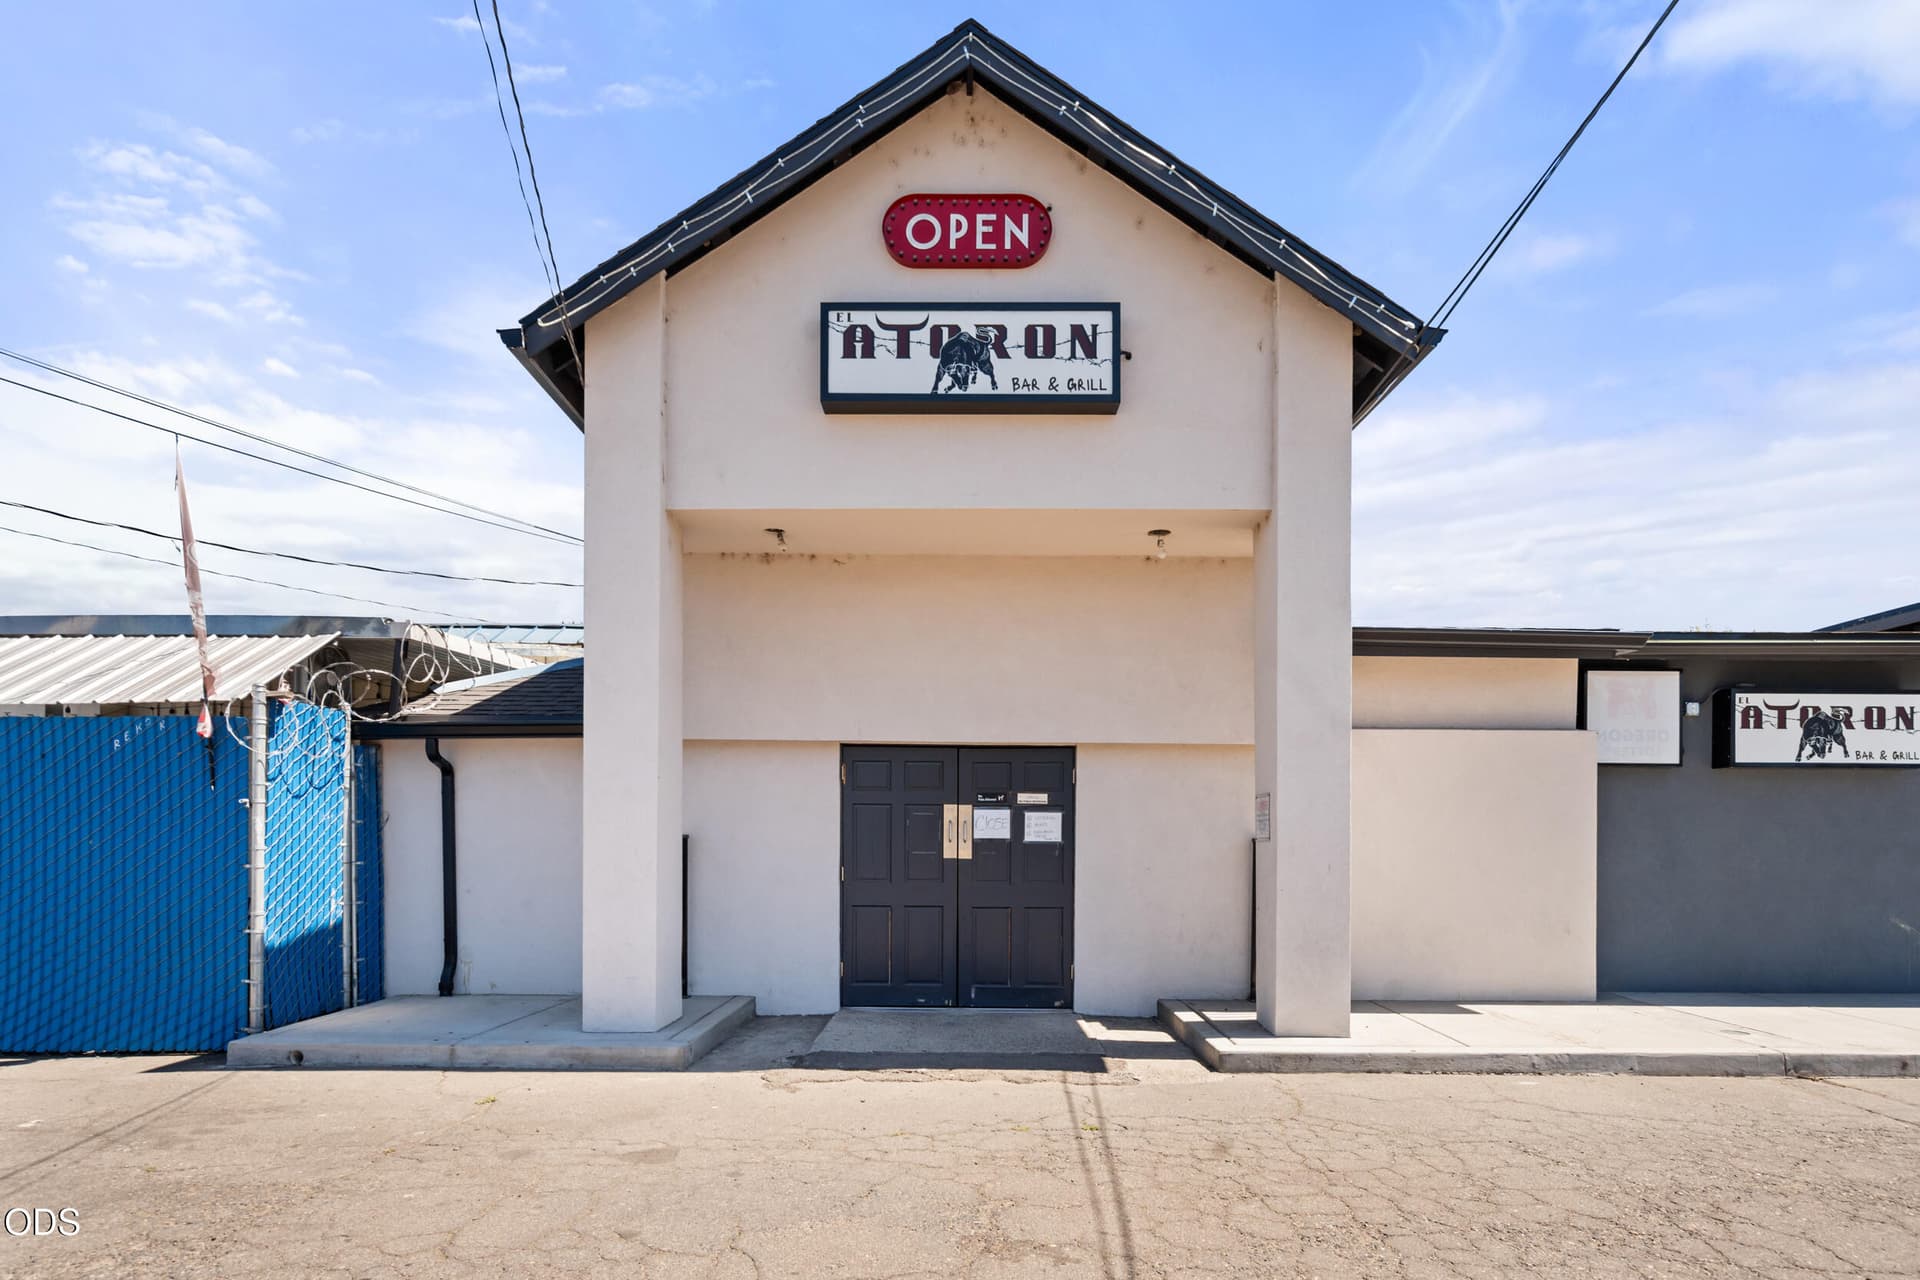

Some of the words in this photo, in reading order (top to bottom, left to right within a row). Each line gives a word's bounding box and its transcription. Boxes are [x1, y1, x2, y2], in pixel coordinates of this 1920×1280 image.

[905, 213, 1029, 250] OPEN
[836, 312, 854, 323] EL
[841, 313, 1100, 359] ATORON
[1011, 378, 1040, 392] BAR
[1048, 377, 1059, 392] &
[1067, 377, 1108, 392] GRILL
[1738, 696, 1751, 704] EL
[1855, 750, 1875, 761] BAR
[1879, 750, 1888, 761] &
[1892, 750, 1920, 761] GRILL
